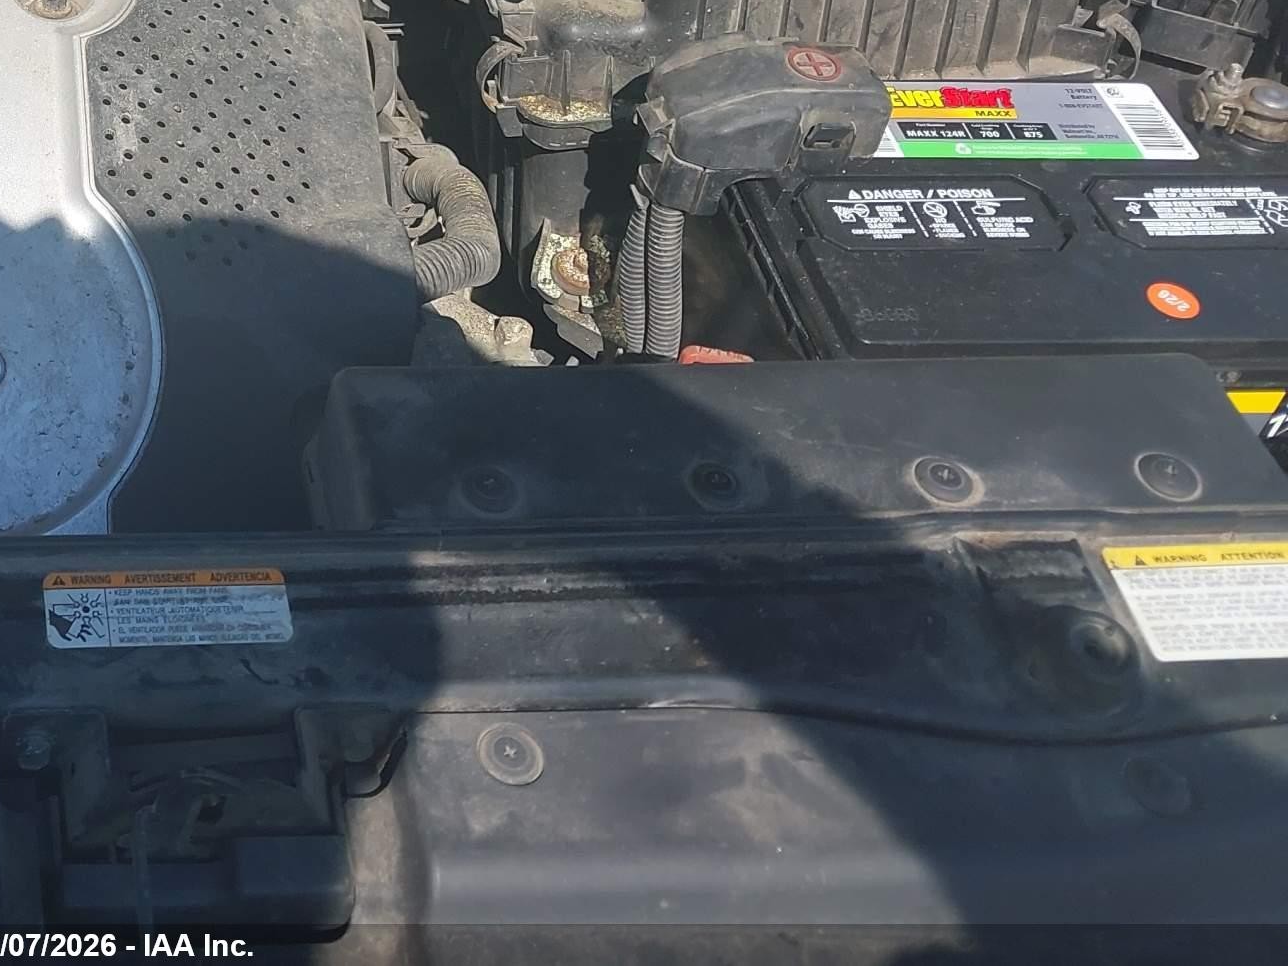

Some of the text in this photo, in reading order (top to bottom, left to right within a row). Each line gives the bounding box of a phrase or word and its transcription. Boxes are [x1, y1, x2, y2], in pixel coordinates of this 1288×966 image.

[906, 130, 967, 138] MAXX 124R
[862, 189, 924, 200] DANGER
[939, 188, 995, 198] POISON
[1152, 551, 1284, 563] WARNING ATTENTION
[71, 571, 272, 585] WARNING AVERTISSEMENT ADVERTENCIA
